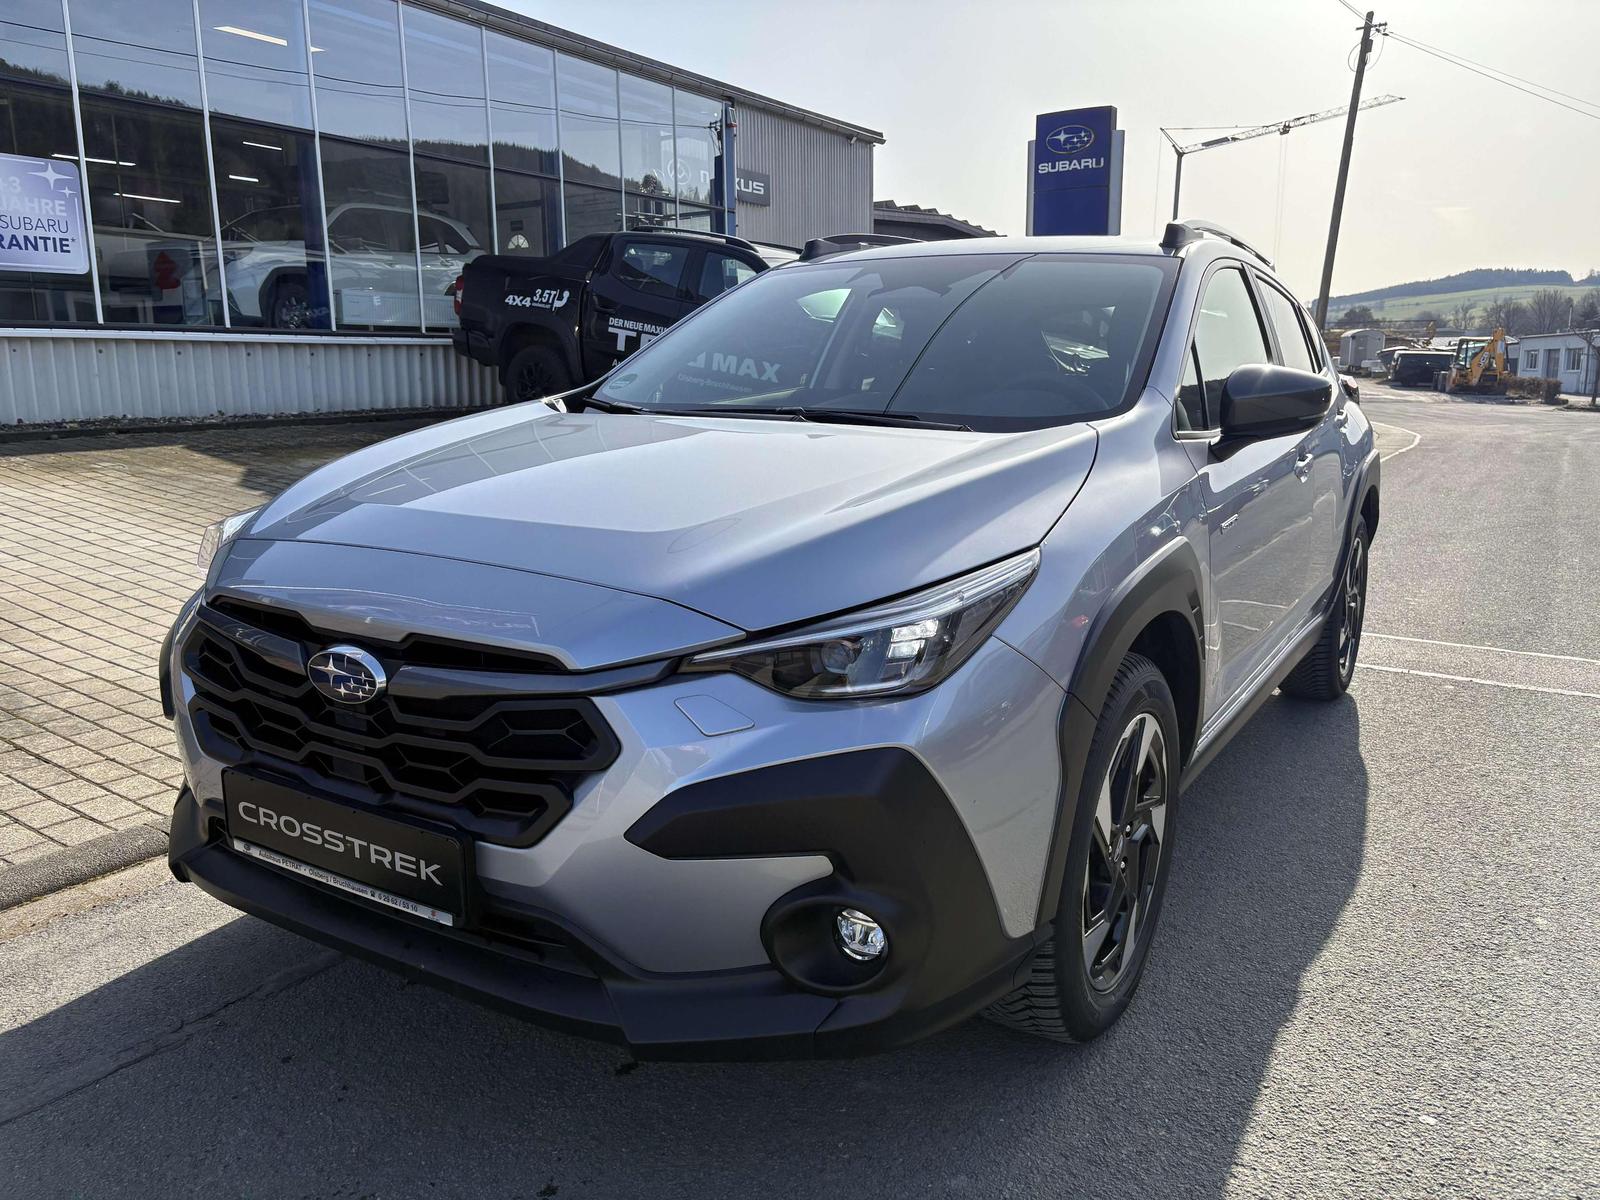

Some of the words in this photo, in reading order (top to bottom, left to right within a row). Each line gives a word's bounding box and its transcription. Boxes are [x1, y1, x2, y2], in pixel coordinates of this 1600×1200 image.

[1038, 157, 1104, 174] SUBARU
[0, 214, 69, 234] SUBARU
[504, 294, 531, 307] 4X4
[609, 317, 624, 328] DER
[624, 319, 643, 331] NEUE
[711, 352, 782, 384] MAX
[238, 801, 444, 887] CROSSTREK
